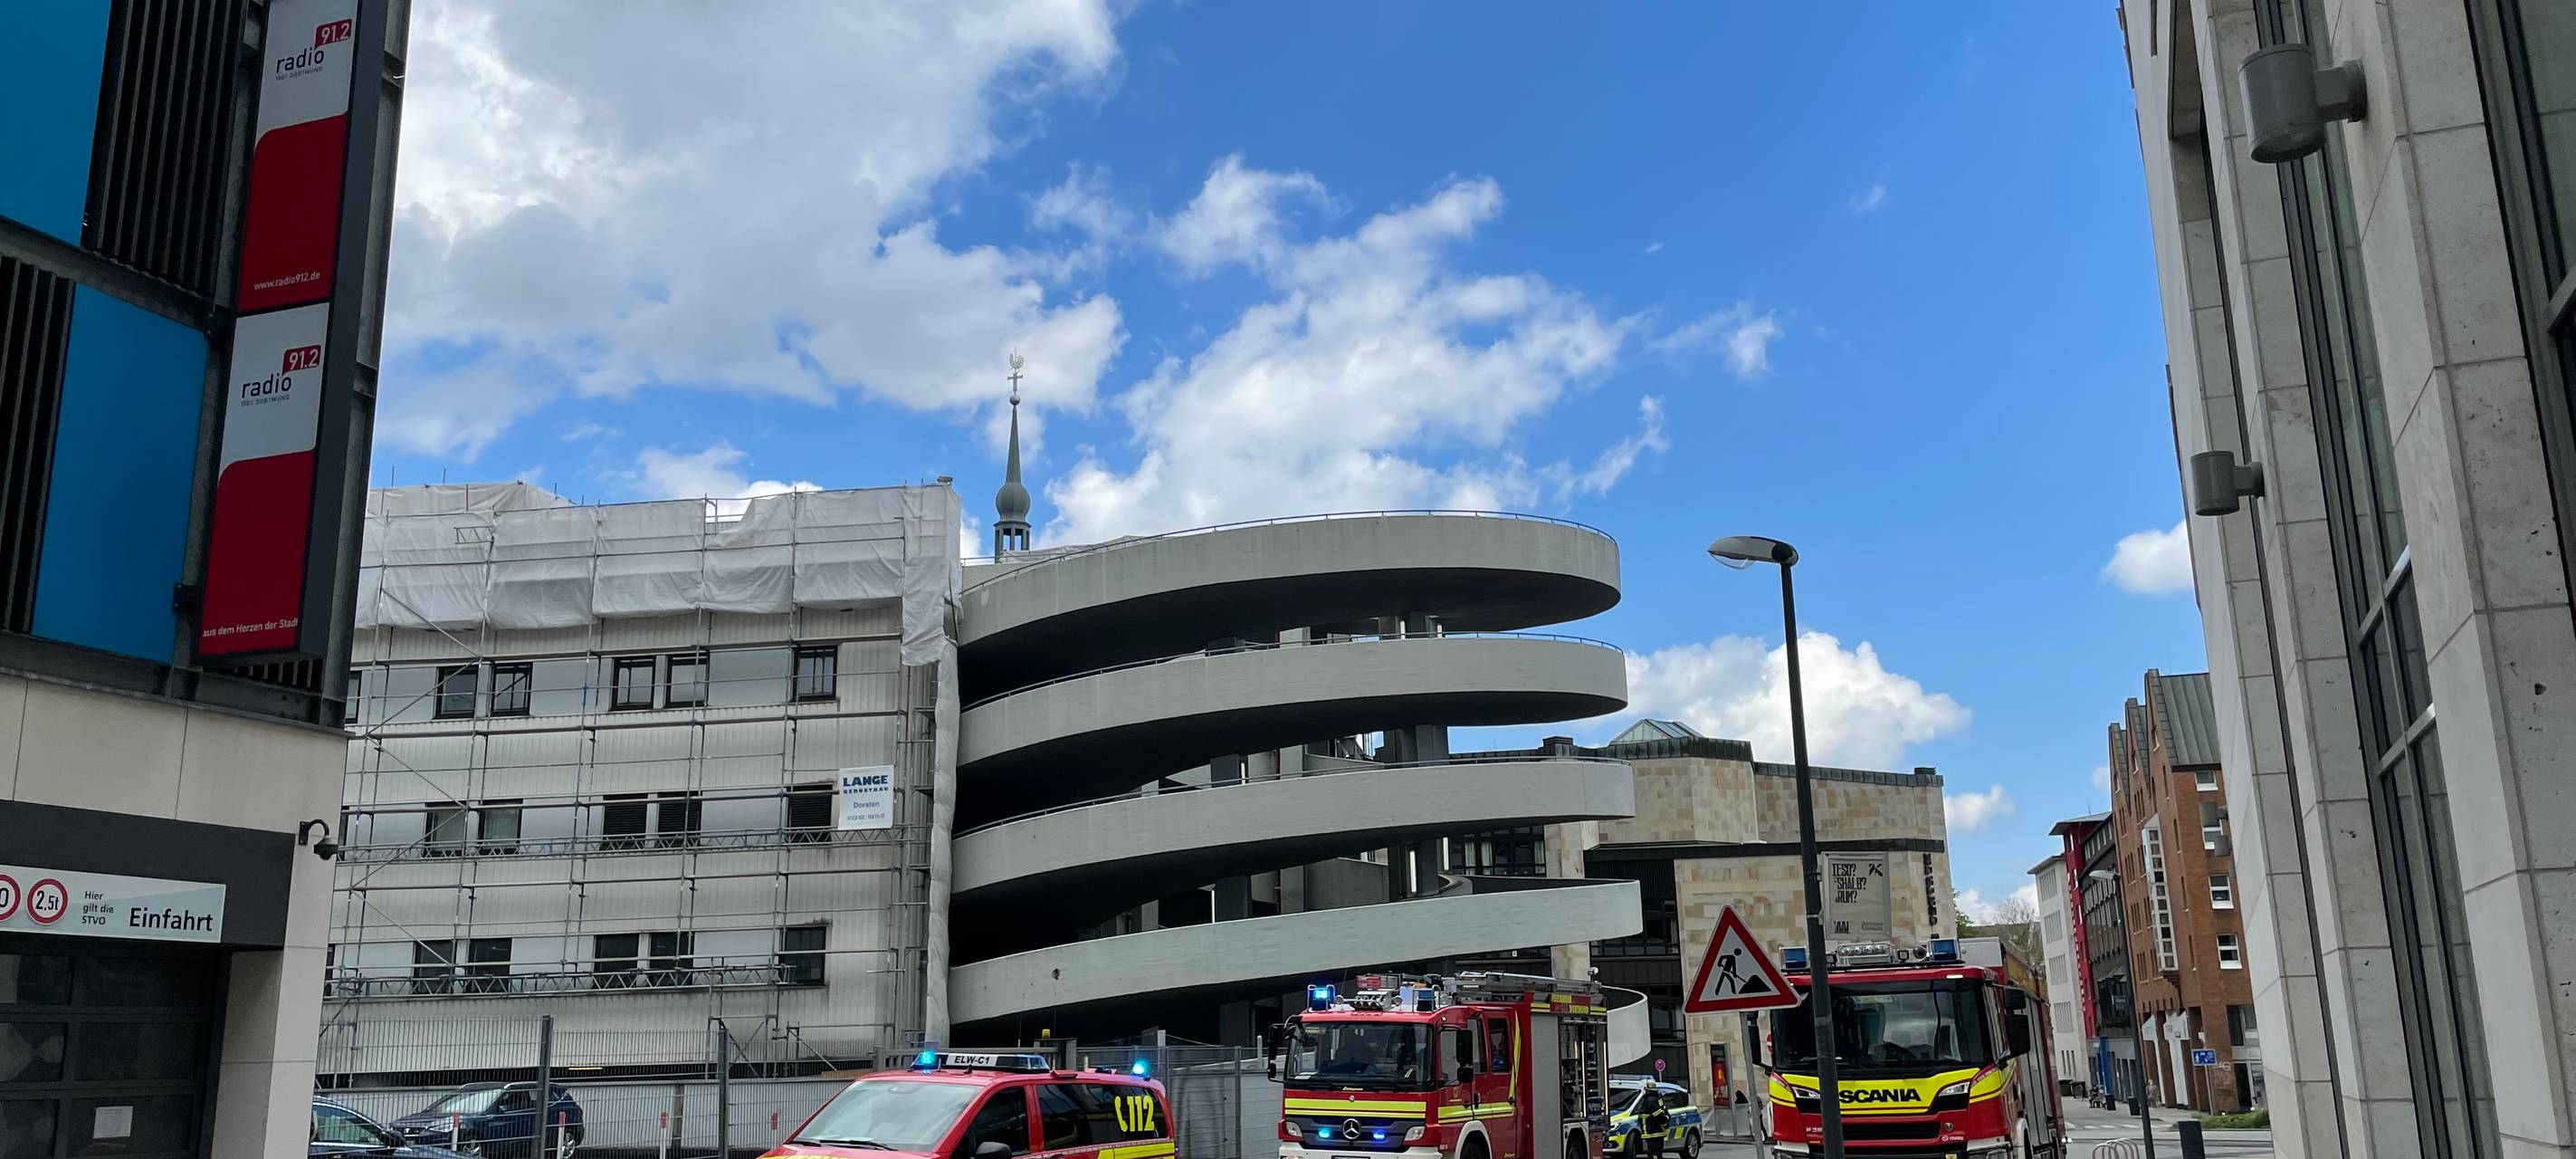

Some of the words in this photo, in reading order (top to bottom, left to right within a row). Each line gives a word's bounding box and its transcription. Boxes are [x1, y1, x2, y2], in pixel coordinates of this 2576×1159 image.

[321, 23, 349, 43] 91.2
[276, 47, 324, 73] radio
[253, 271, 320, 291] www.radio912.de
[290, 349, 319, 370] 91.2
[242, 373, 291, 398] radio
[203, 628, 216, 637] aus
[217, 626, 234, 636] dem
[235, 623, 263, 634] Herzen
[264, 621, 277, 630] der
[843, 775, 889, 787] LANGE
[84, 891, 104, 900] Hier
[82, 904, 98, 915] gilt
[100, 905, 114, 914] die
[81, 915, 106, 925] STVO
[129, 906, 214, 932] Einfahrt
[954, 1055, 990, 1065] ELW-C1
[1838, 1088, 1922, 1104] SCANIA
[1127, 1096, 1155, 1132] 112
